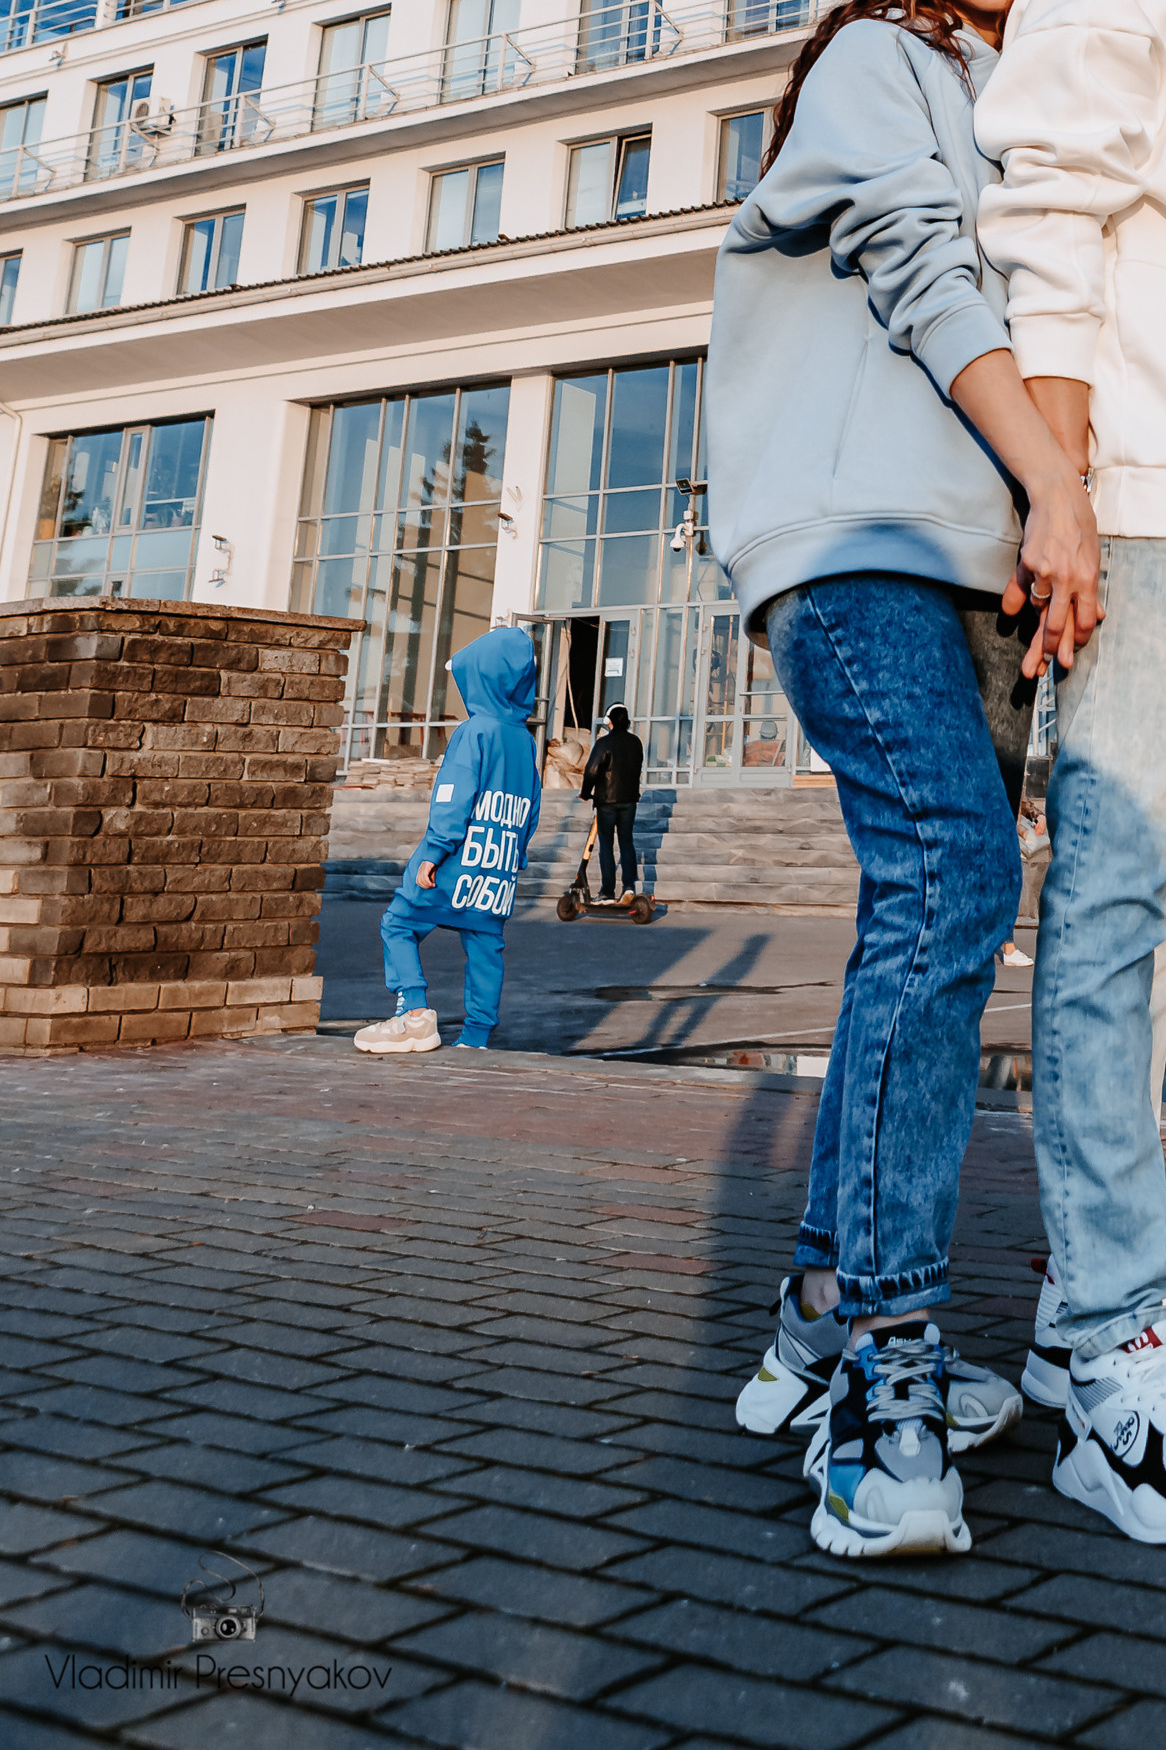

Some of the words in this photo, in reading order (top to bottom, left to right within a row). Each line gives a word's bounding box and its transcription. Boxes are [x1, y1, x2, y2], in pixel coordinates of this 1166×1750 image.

[471, 790, 531, 829] МОДНО
[461, 825, 520, 873] БЫТЬ
[451, 874, 517, 916] СОБОЙ
